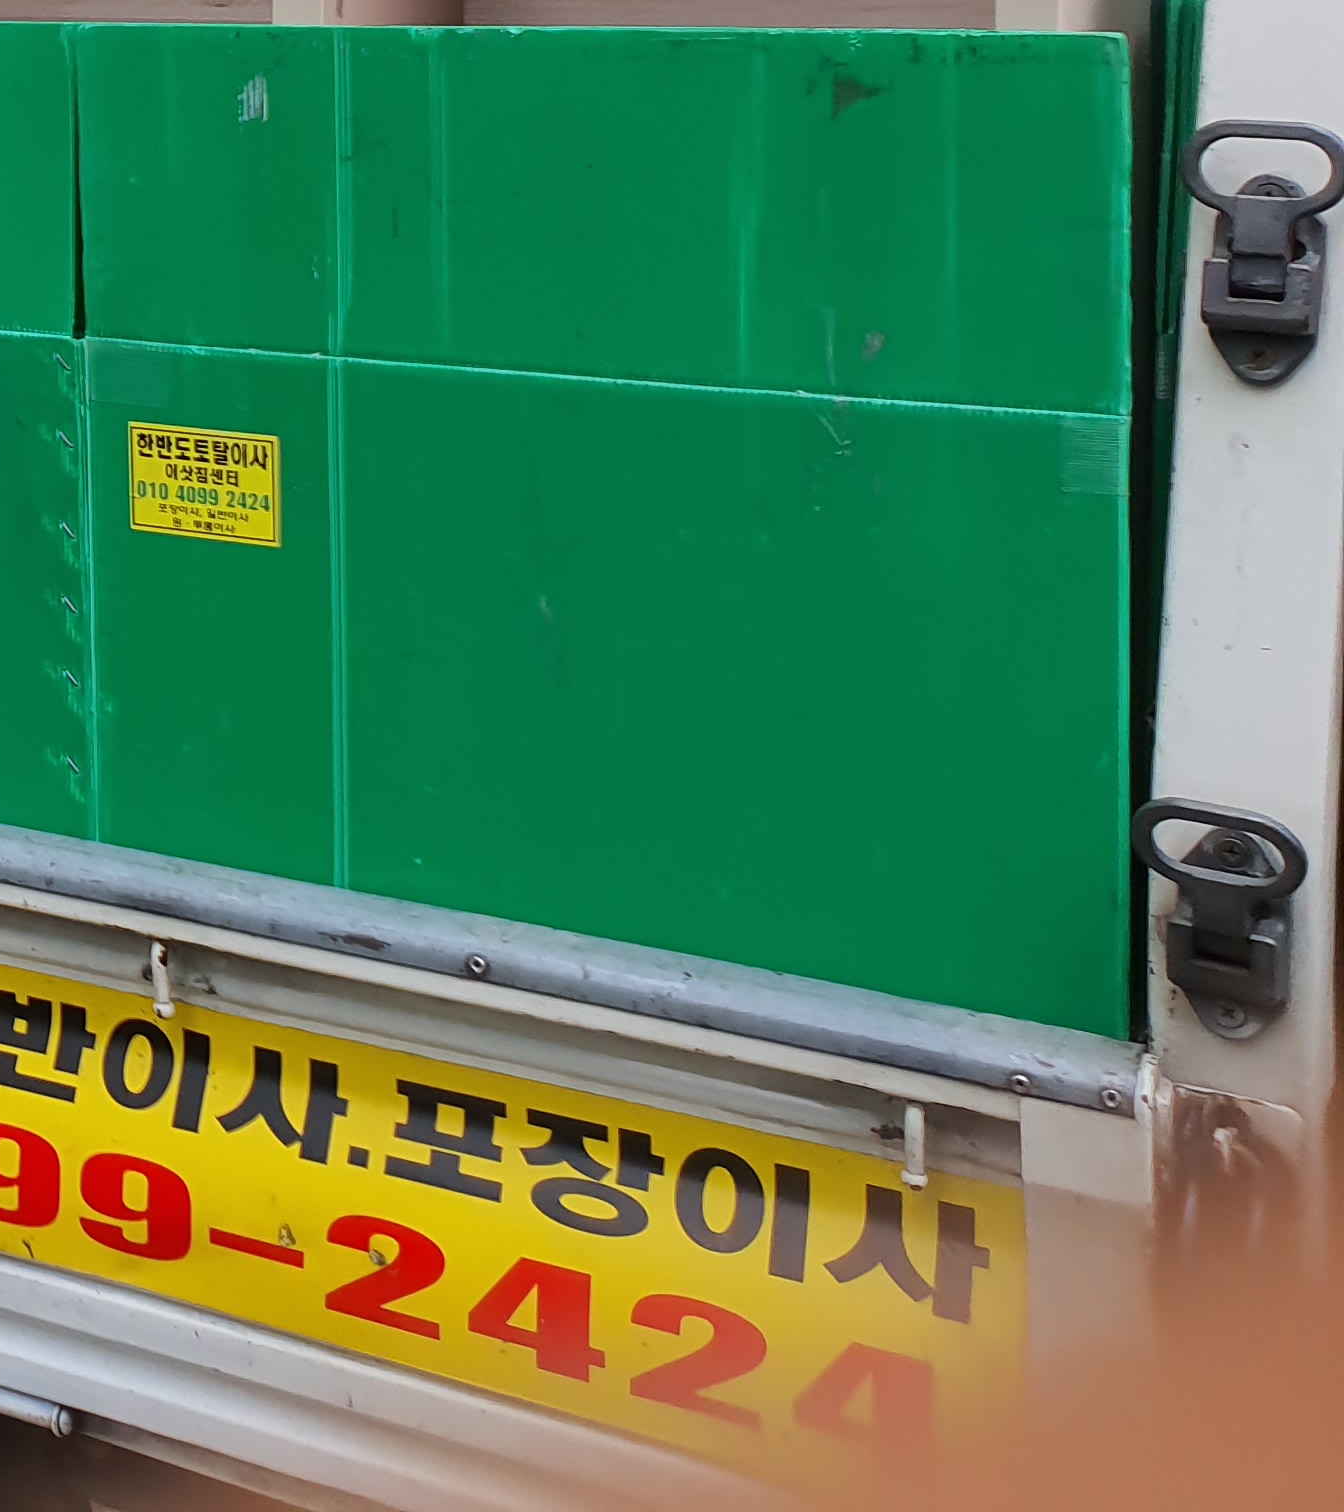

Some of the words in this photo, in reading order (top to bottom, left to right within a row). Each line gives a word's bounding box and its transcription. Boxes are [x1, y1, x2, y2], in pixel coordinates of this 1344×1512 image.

[136, 432, 268, 470] 한반도토탈이사
[165, 462, 240, 487] 이삿짐센터
[136, 480, 169, 500] 010
[175, 484, 219, 506] 4099
[225, 490, 270, 512] 2424
